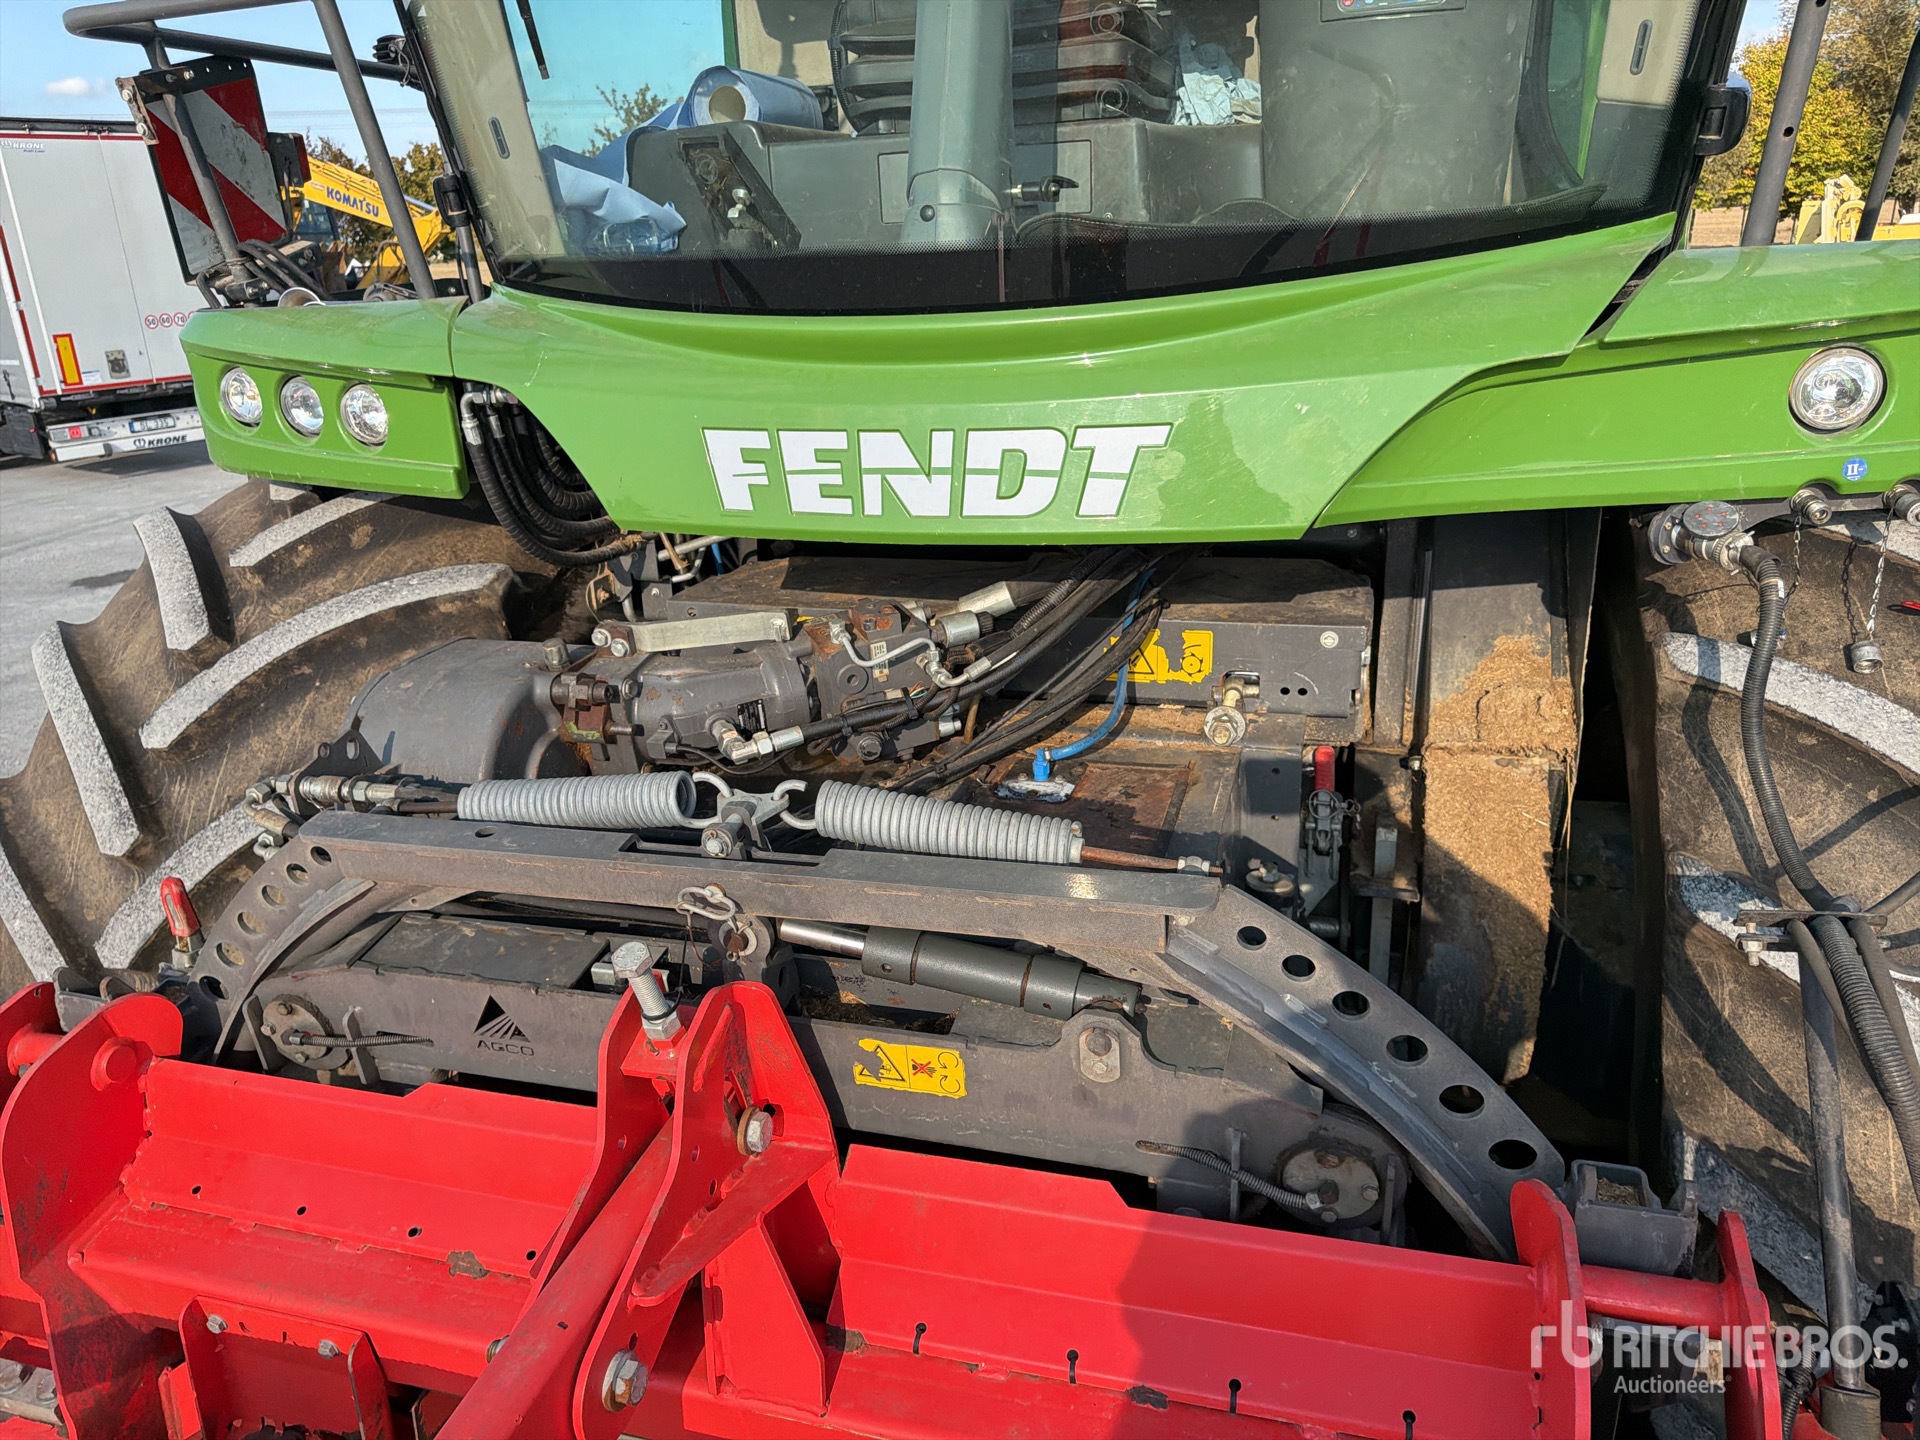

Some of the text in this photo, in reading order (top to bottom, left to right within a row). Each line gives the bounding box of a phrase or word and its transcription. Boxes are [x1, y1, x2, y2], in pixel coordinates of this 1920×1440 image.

[326, 186, 379, 217] KOMATSU
[147, 434, 188, 447] KRONE
[703, 423, 1173, 518] FENDT
[477, 1040, 534, 1056] AGCO
